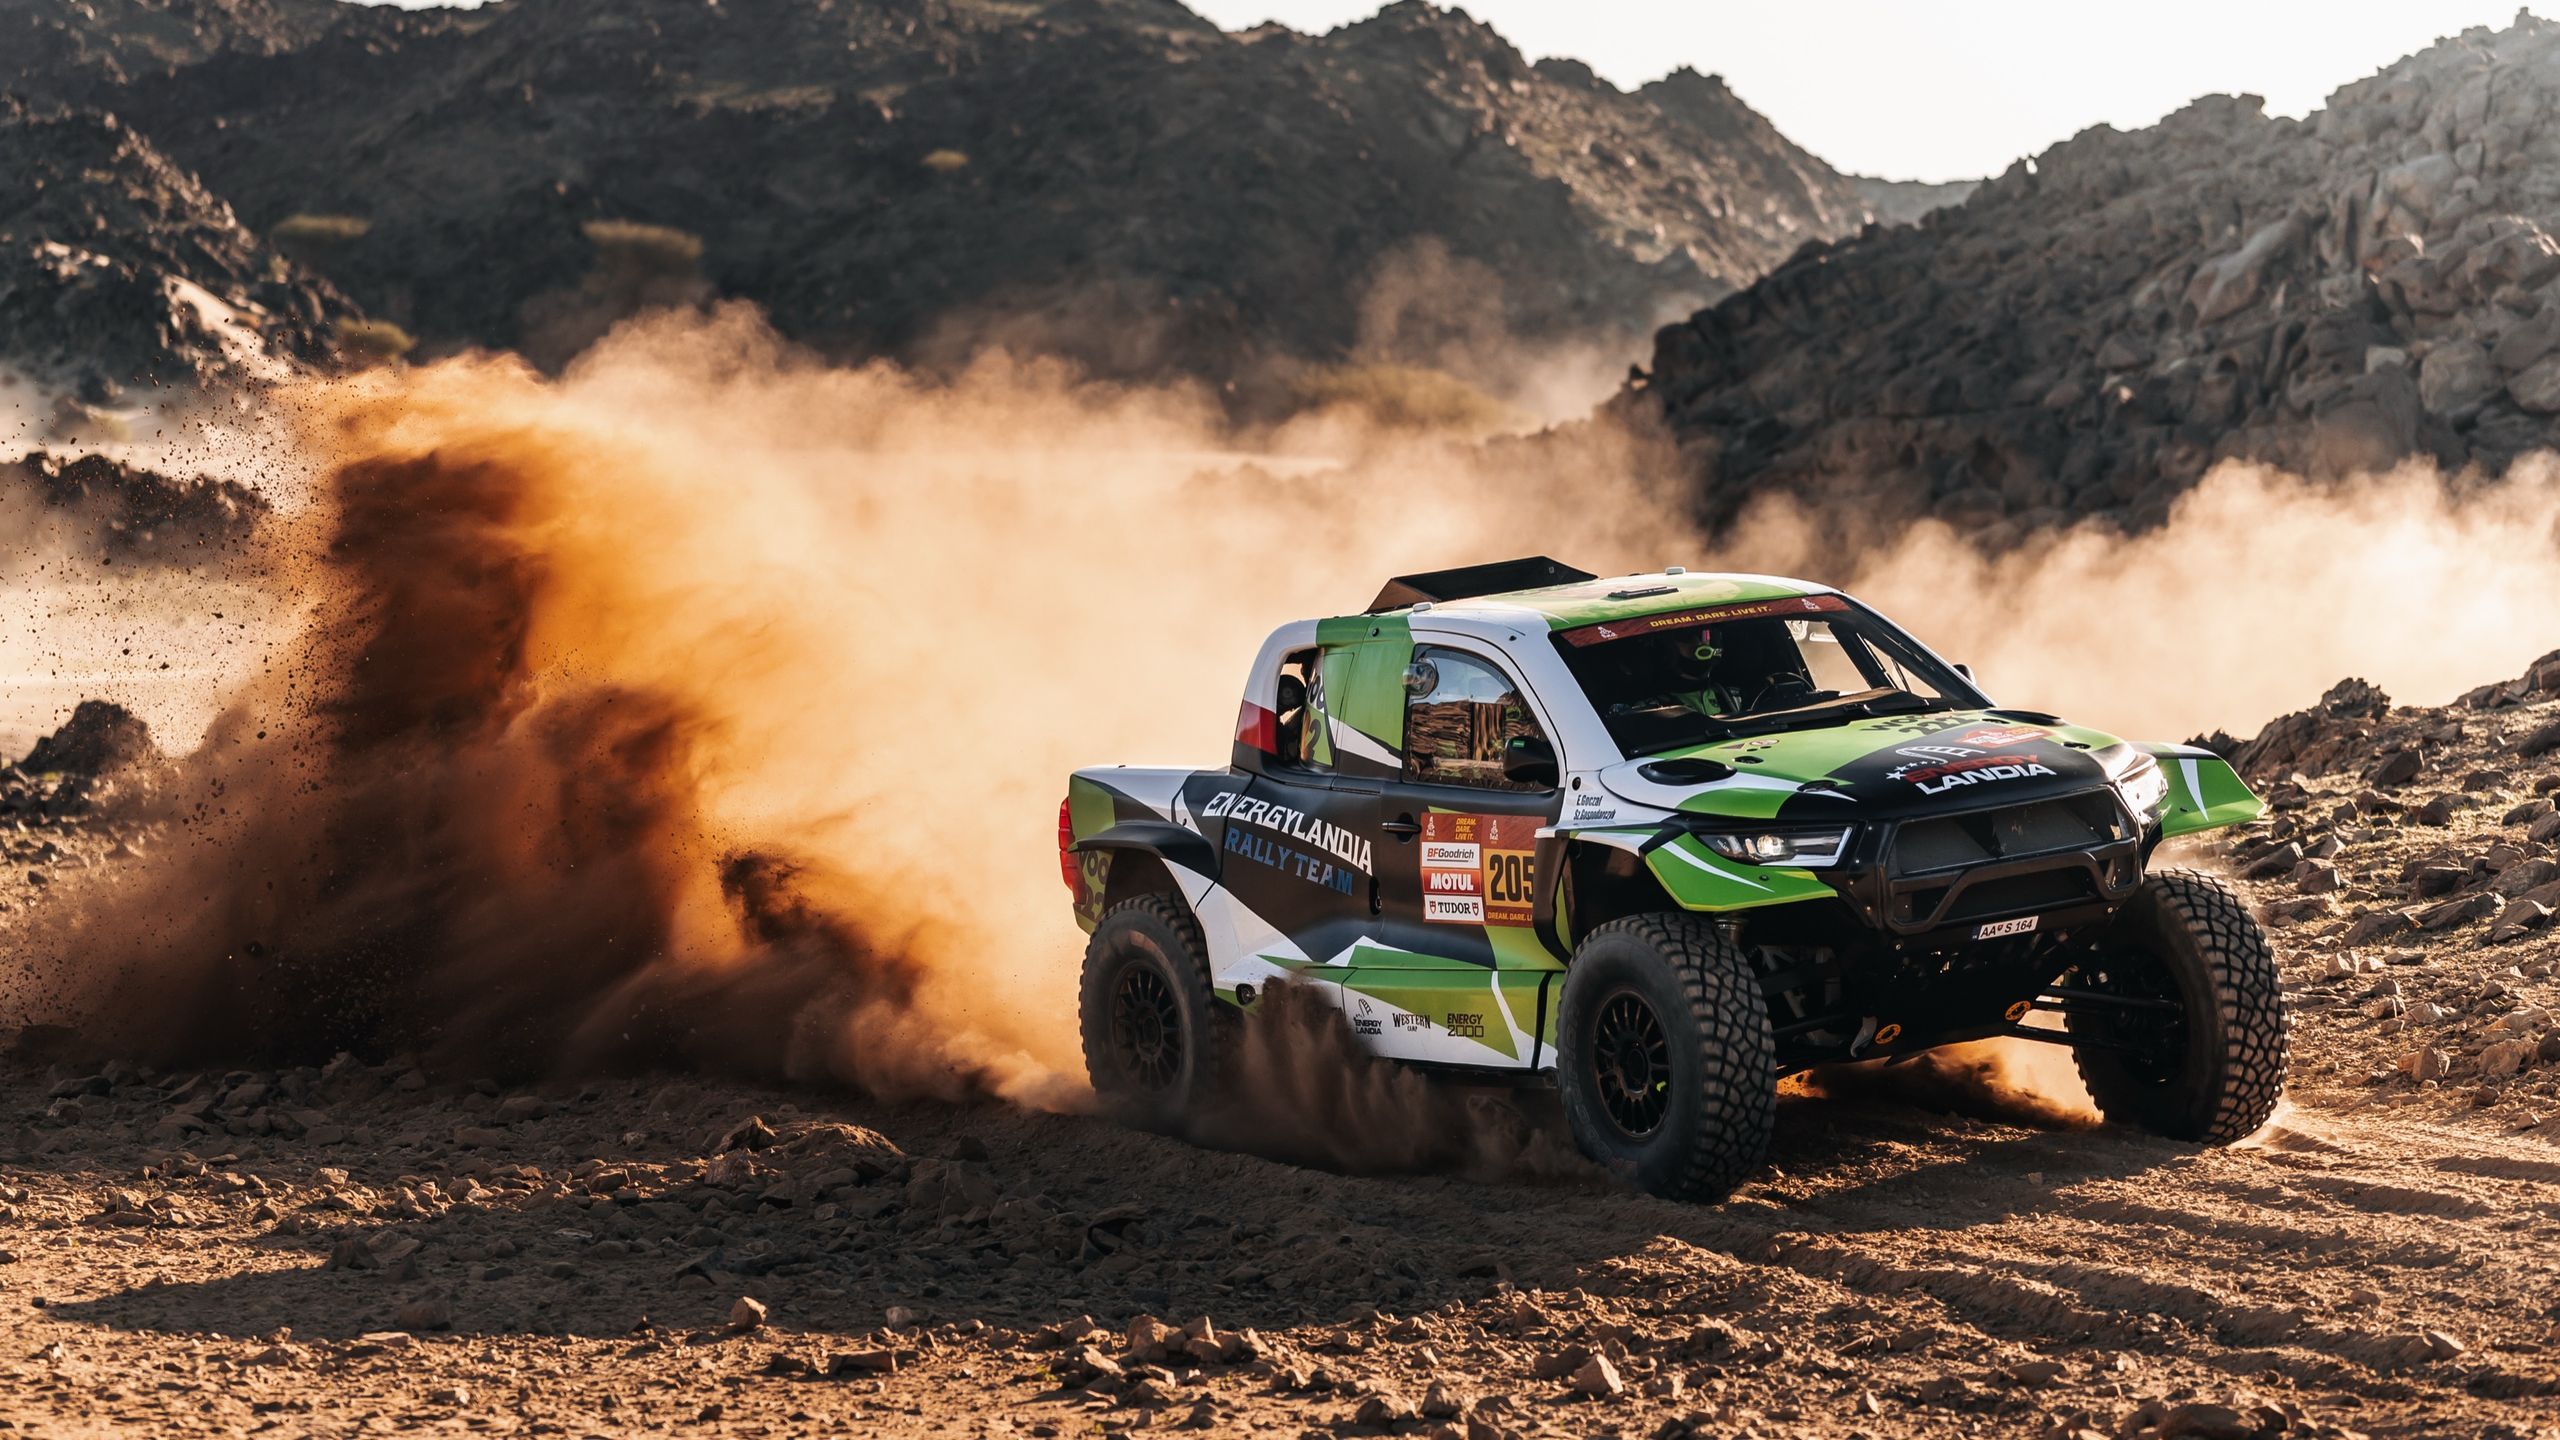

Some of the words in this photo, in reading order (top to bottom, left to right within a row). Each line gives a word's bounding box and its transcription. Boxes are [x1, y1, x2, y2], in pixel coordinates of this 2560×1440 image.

[1650, 616, 1695, 628] DREAM.
[1698, 611, 1731, 621] DARE.
[1732, 607, 1756, 617] LIVE
[1757, 605, 1772, 613] IT.
[1915, 763, 2057, 795] LANDIA
[1201, 791, 1373, 877] ENERGYLANDIA
[1224, 826, 1292, 871] RALLY
[1293, 853, 1354, 896] TEAM
[1427, 848, 1474, 860] BFGoodrich
[1430, 872, 1474, 891] MOTUL
[1489, 854, 1533, 903] 205
[1438, 902, 1471, 915] TUDOR
[1980, 925, 1996, 938] AA
[2005, 922, 2013, 933] S
[2015, 919, 2033, 932] 164
[1355, 1019, 1382, 1028] ENERGY
[1392, 1013, 1431, 1029] WESTERN
[1447, 1013, 1484, 1025] ENERGY
[1355, 1027, 1383, 1035] LANDIA
[1447, 1025, 1485, 1038] 2000
